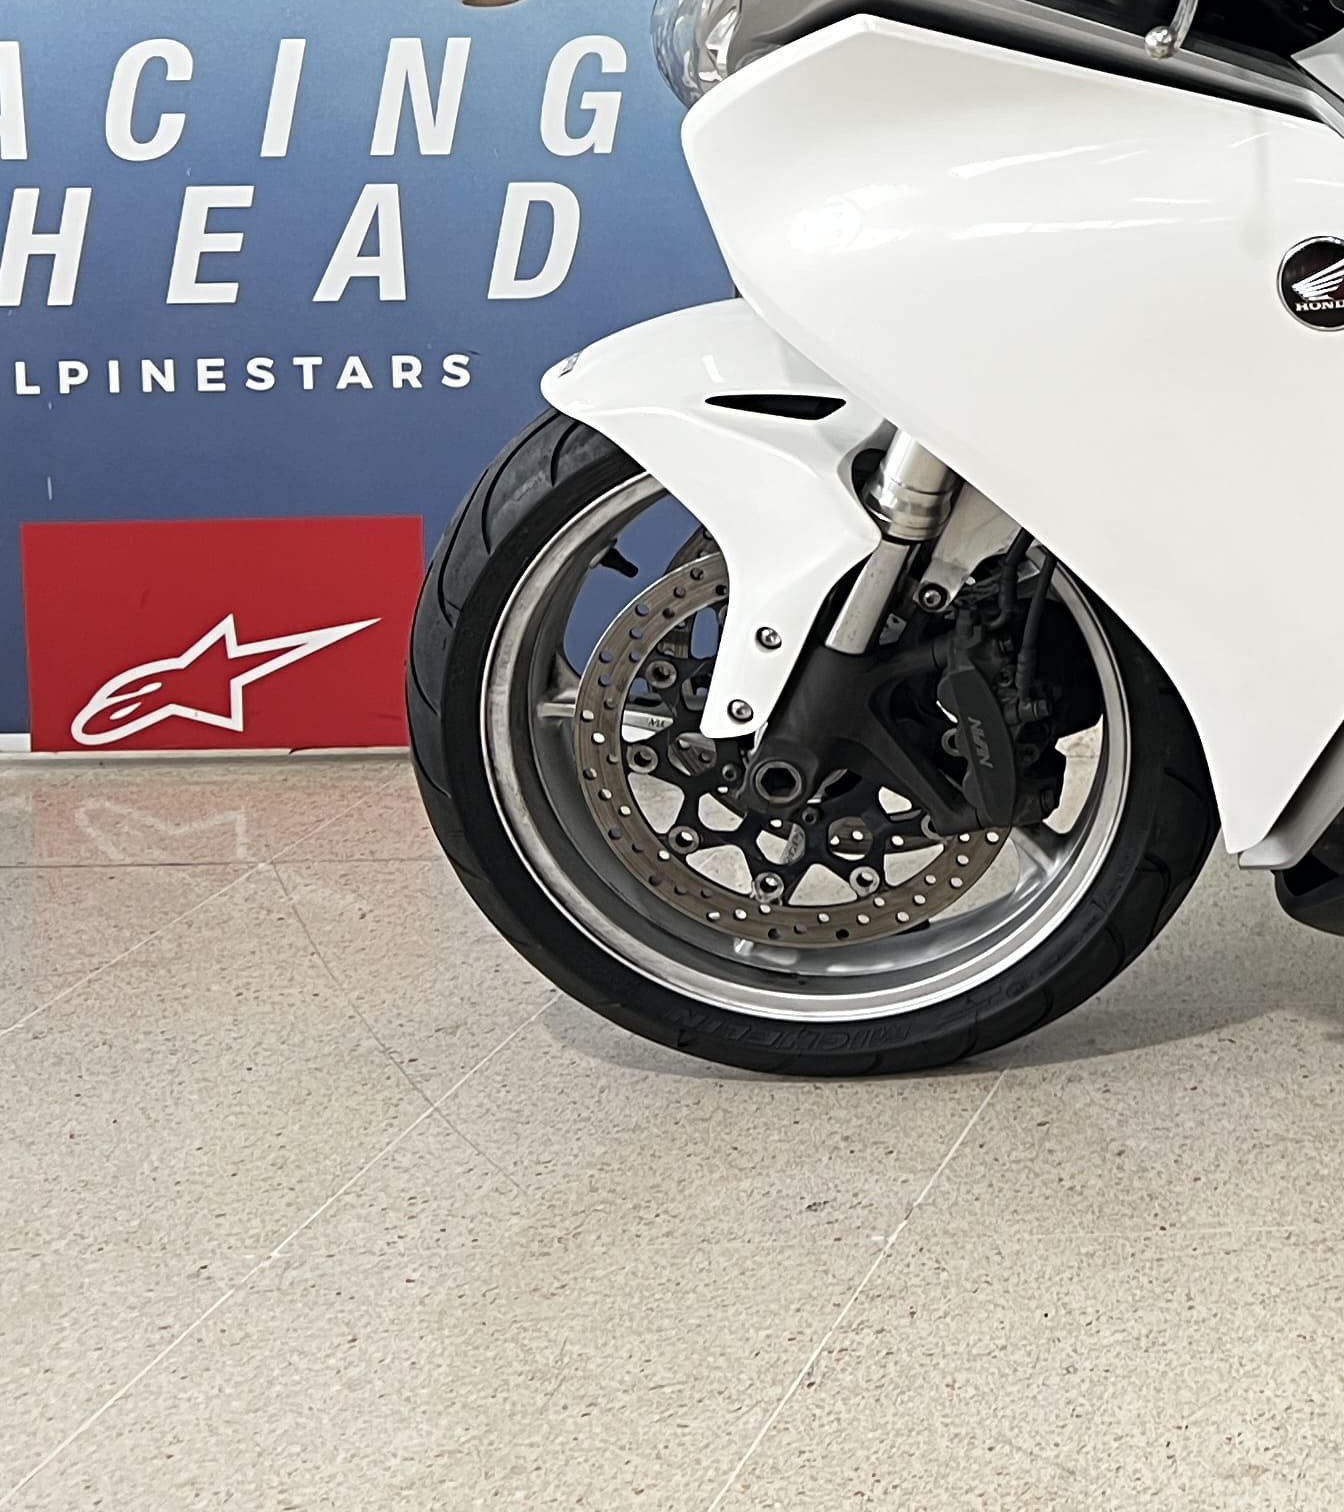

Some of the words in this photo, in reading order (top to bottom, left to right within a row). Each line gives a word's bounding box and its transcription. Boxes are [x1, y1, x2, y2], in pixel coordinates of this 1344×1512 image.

[0, 183, 579, 305] HEAD
[16, 355, 470, 394] LPINESTARS
[967, 716, 993, 768] NISSIN
